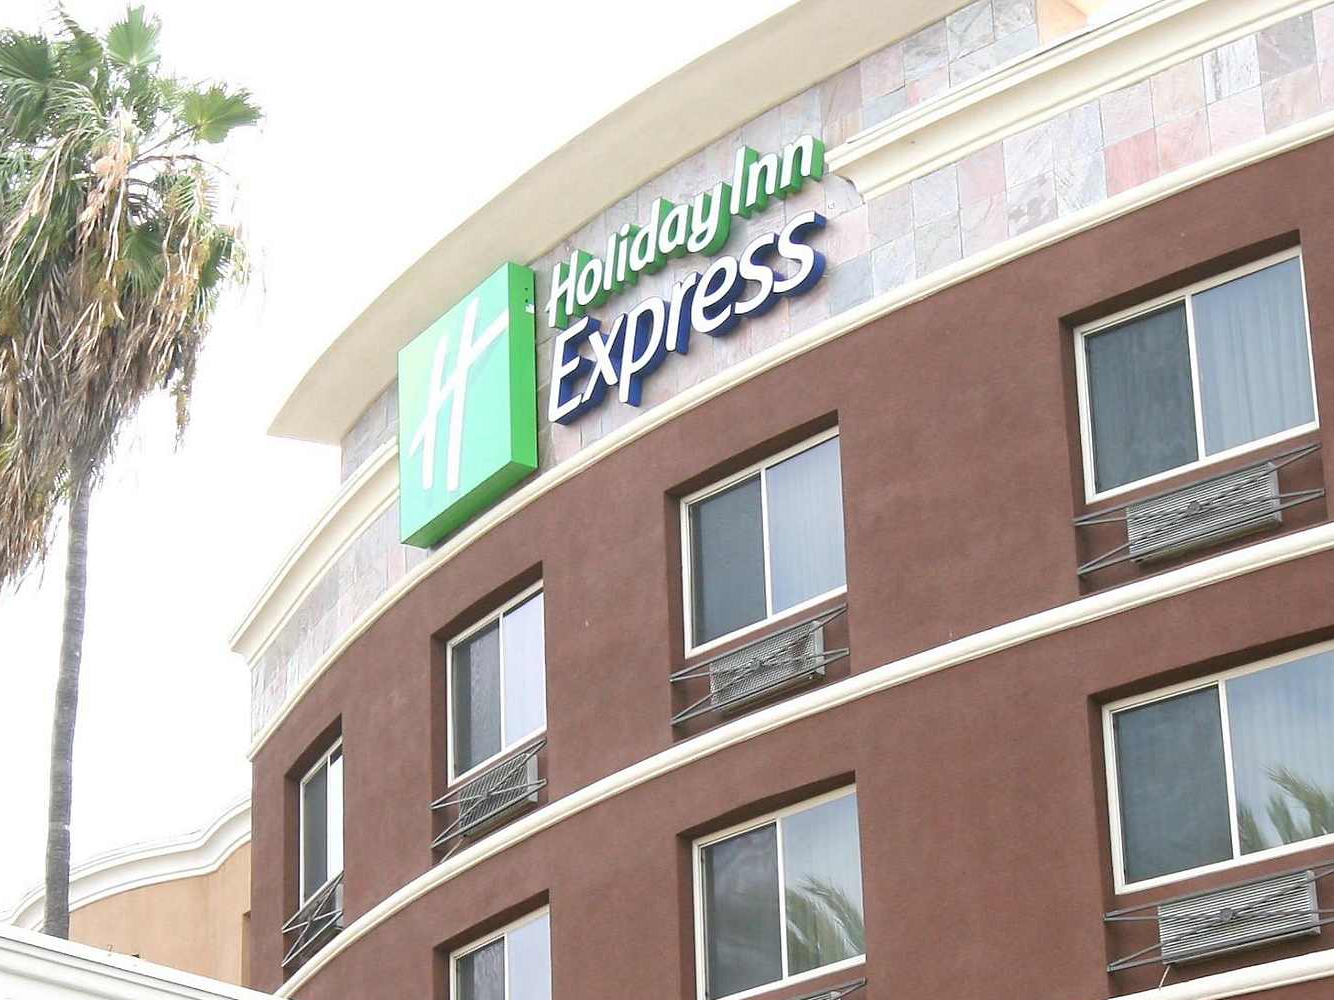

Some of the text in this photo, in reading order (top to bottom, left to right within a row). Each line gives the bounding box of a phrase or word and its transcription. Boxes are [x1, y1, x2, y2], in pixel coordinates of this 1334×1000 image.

[546, 134, 822, 329] Holiday Inn
[548, 211, 824, 425] Express
